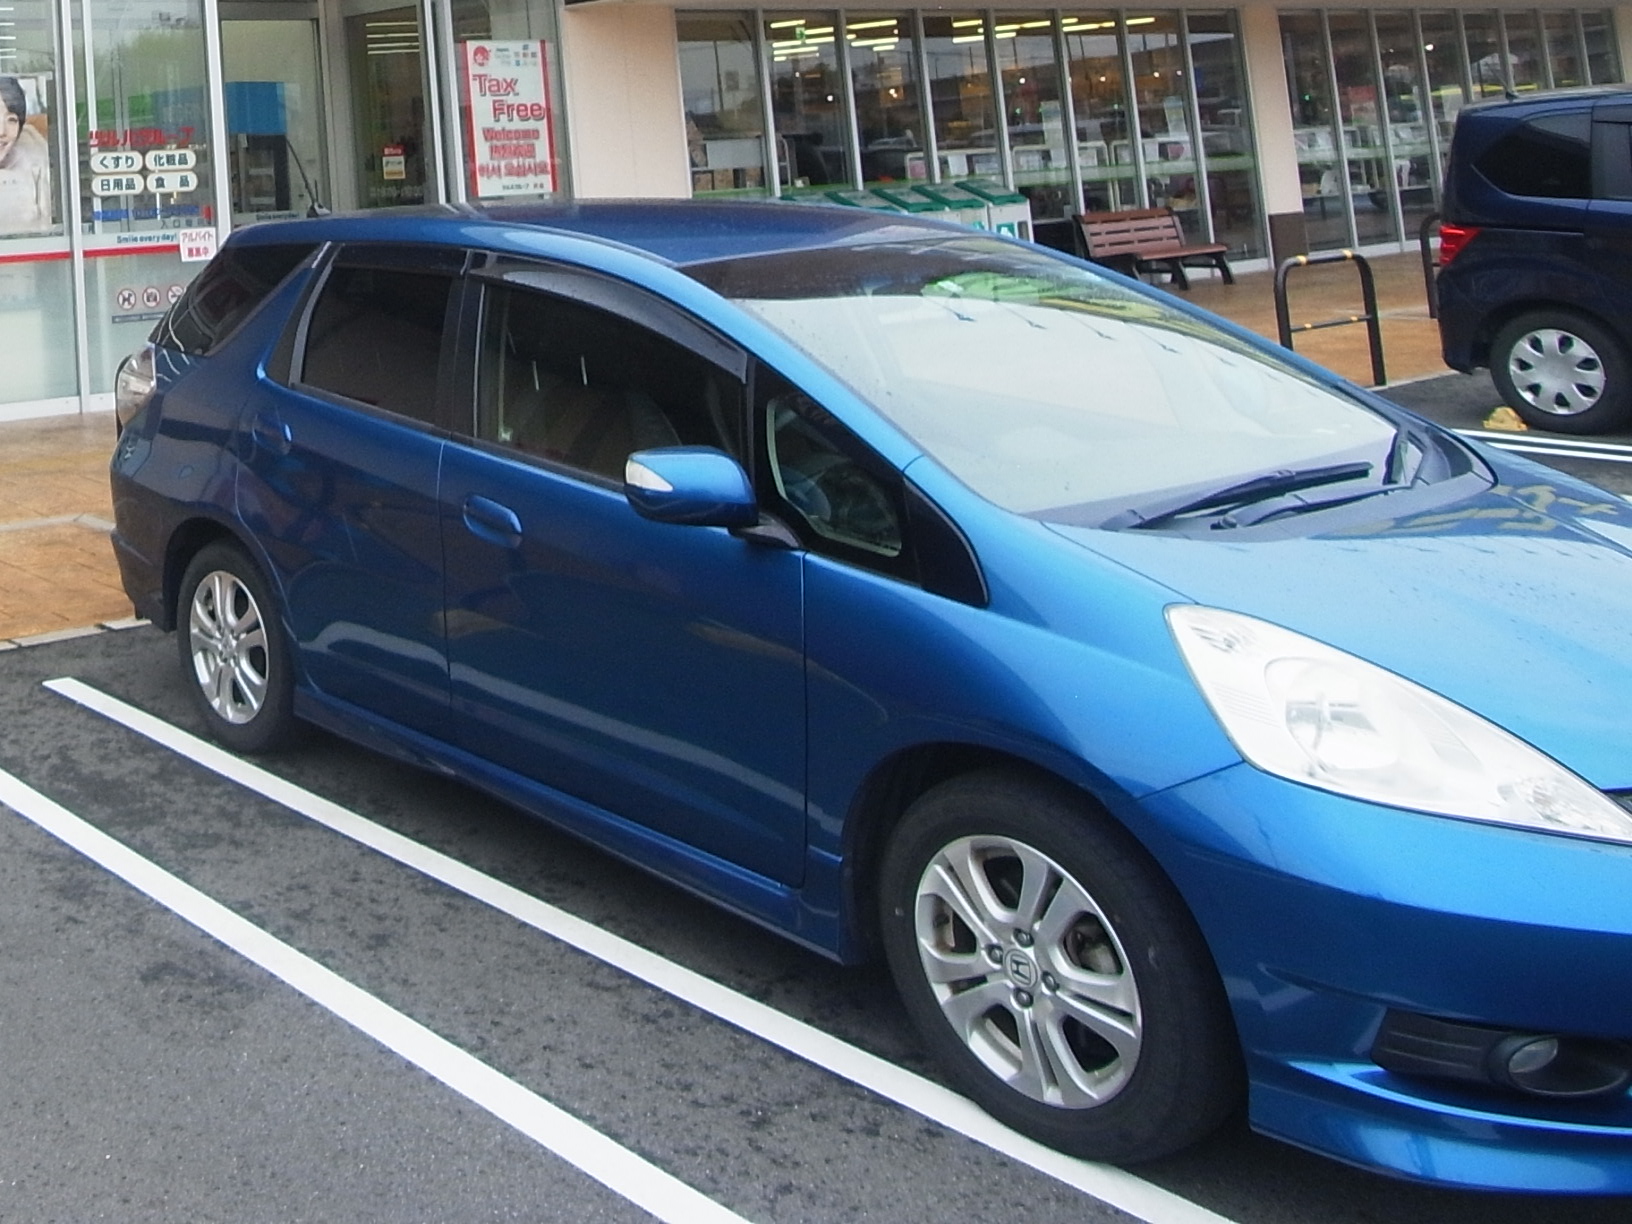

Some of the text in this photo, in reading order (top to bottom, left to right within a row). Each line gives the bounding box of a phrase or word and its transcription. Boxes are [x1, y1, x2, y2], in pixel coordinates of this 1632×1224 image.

[472, 74, 519, 97] Tax
[492, 99, 545, 122] Free
[99, 155, 135, 169] くすり
[153, 153, 189, 167] 化粧品
[100, 178, 137, 192] 日用品
